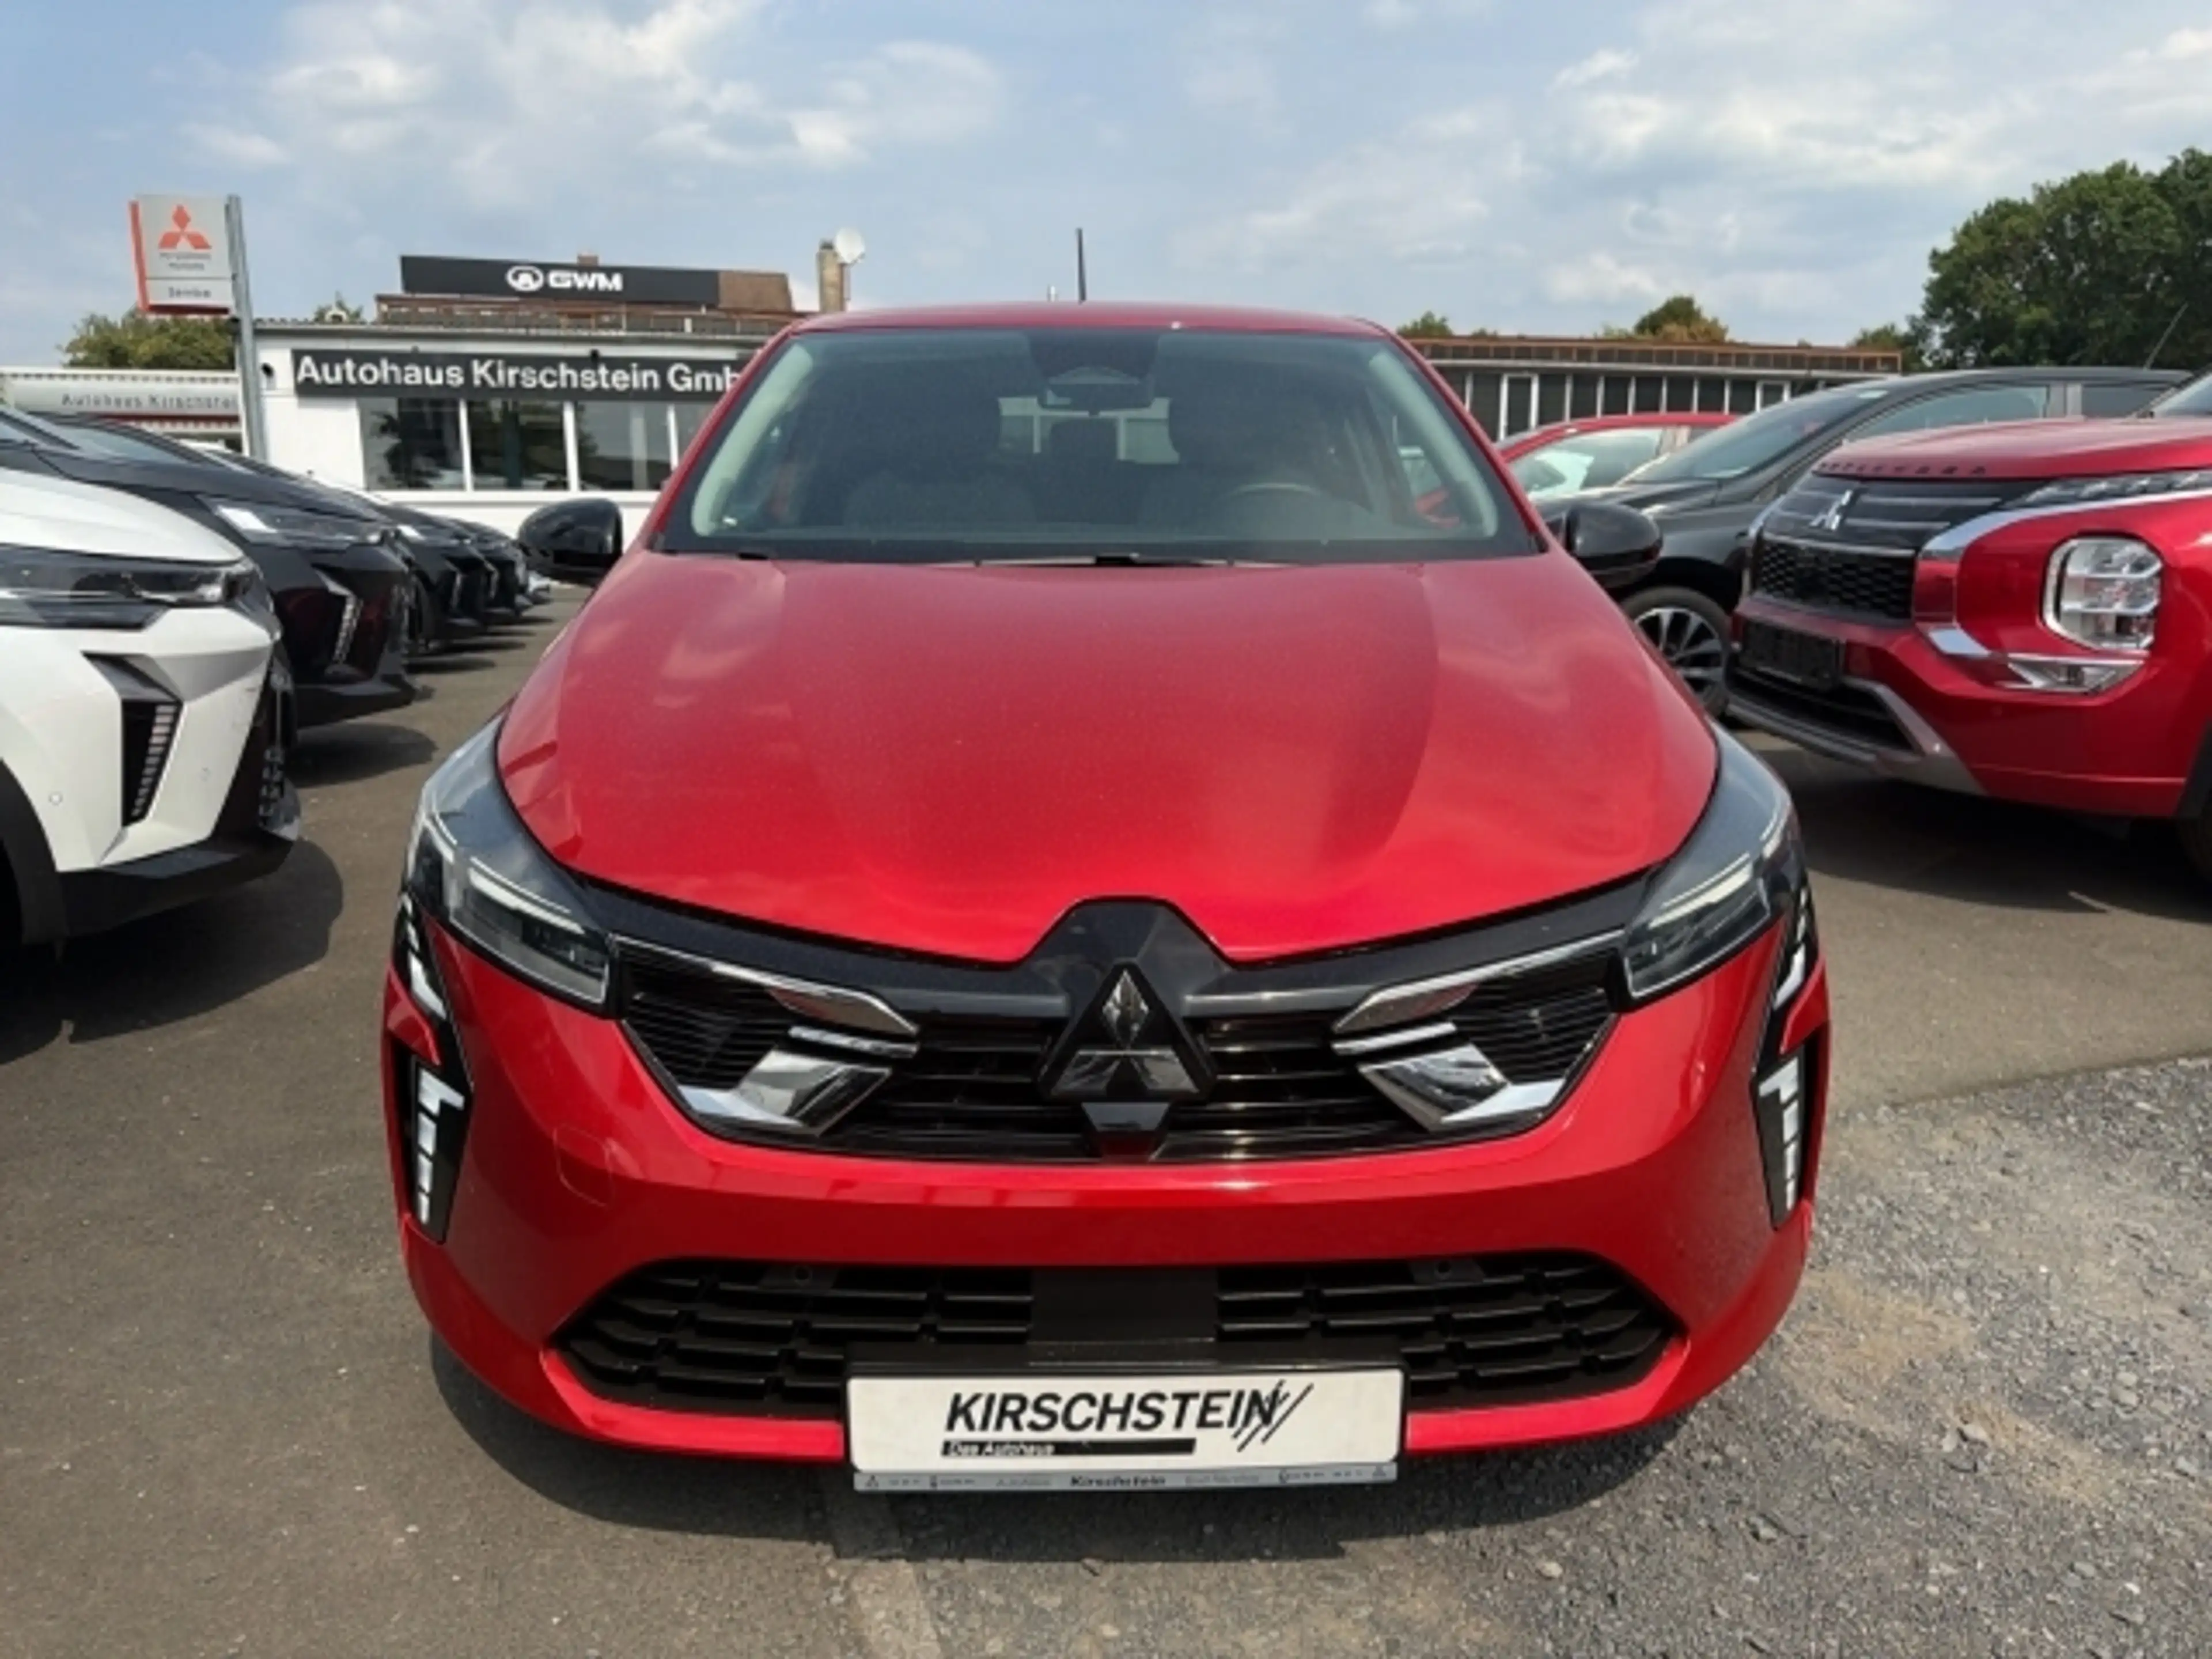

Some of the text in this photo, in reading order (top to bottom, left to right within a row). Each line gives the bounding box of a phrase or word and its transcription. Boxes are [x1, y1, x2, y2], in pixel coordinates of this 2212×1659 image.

[549, 269, 623, 291] GWM
[297, 355, 464, 387] Autohaus
[472, 359, 660, 392] Kirschstein
[945, 1389, 1281, 1433] KIRSCHSTEIN
